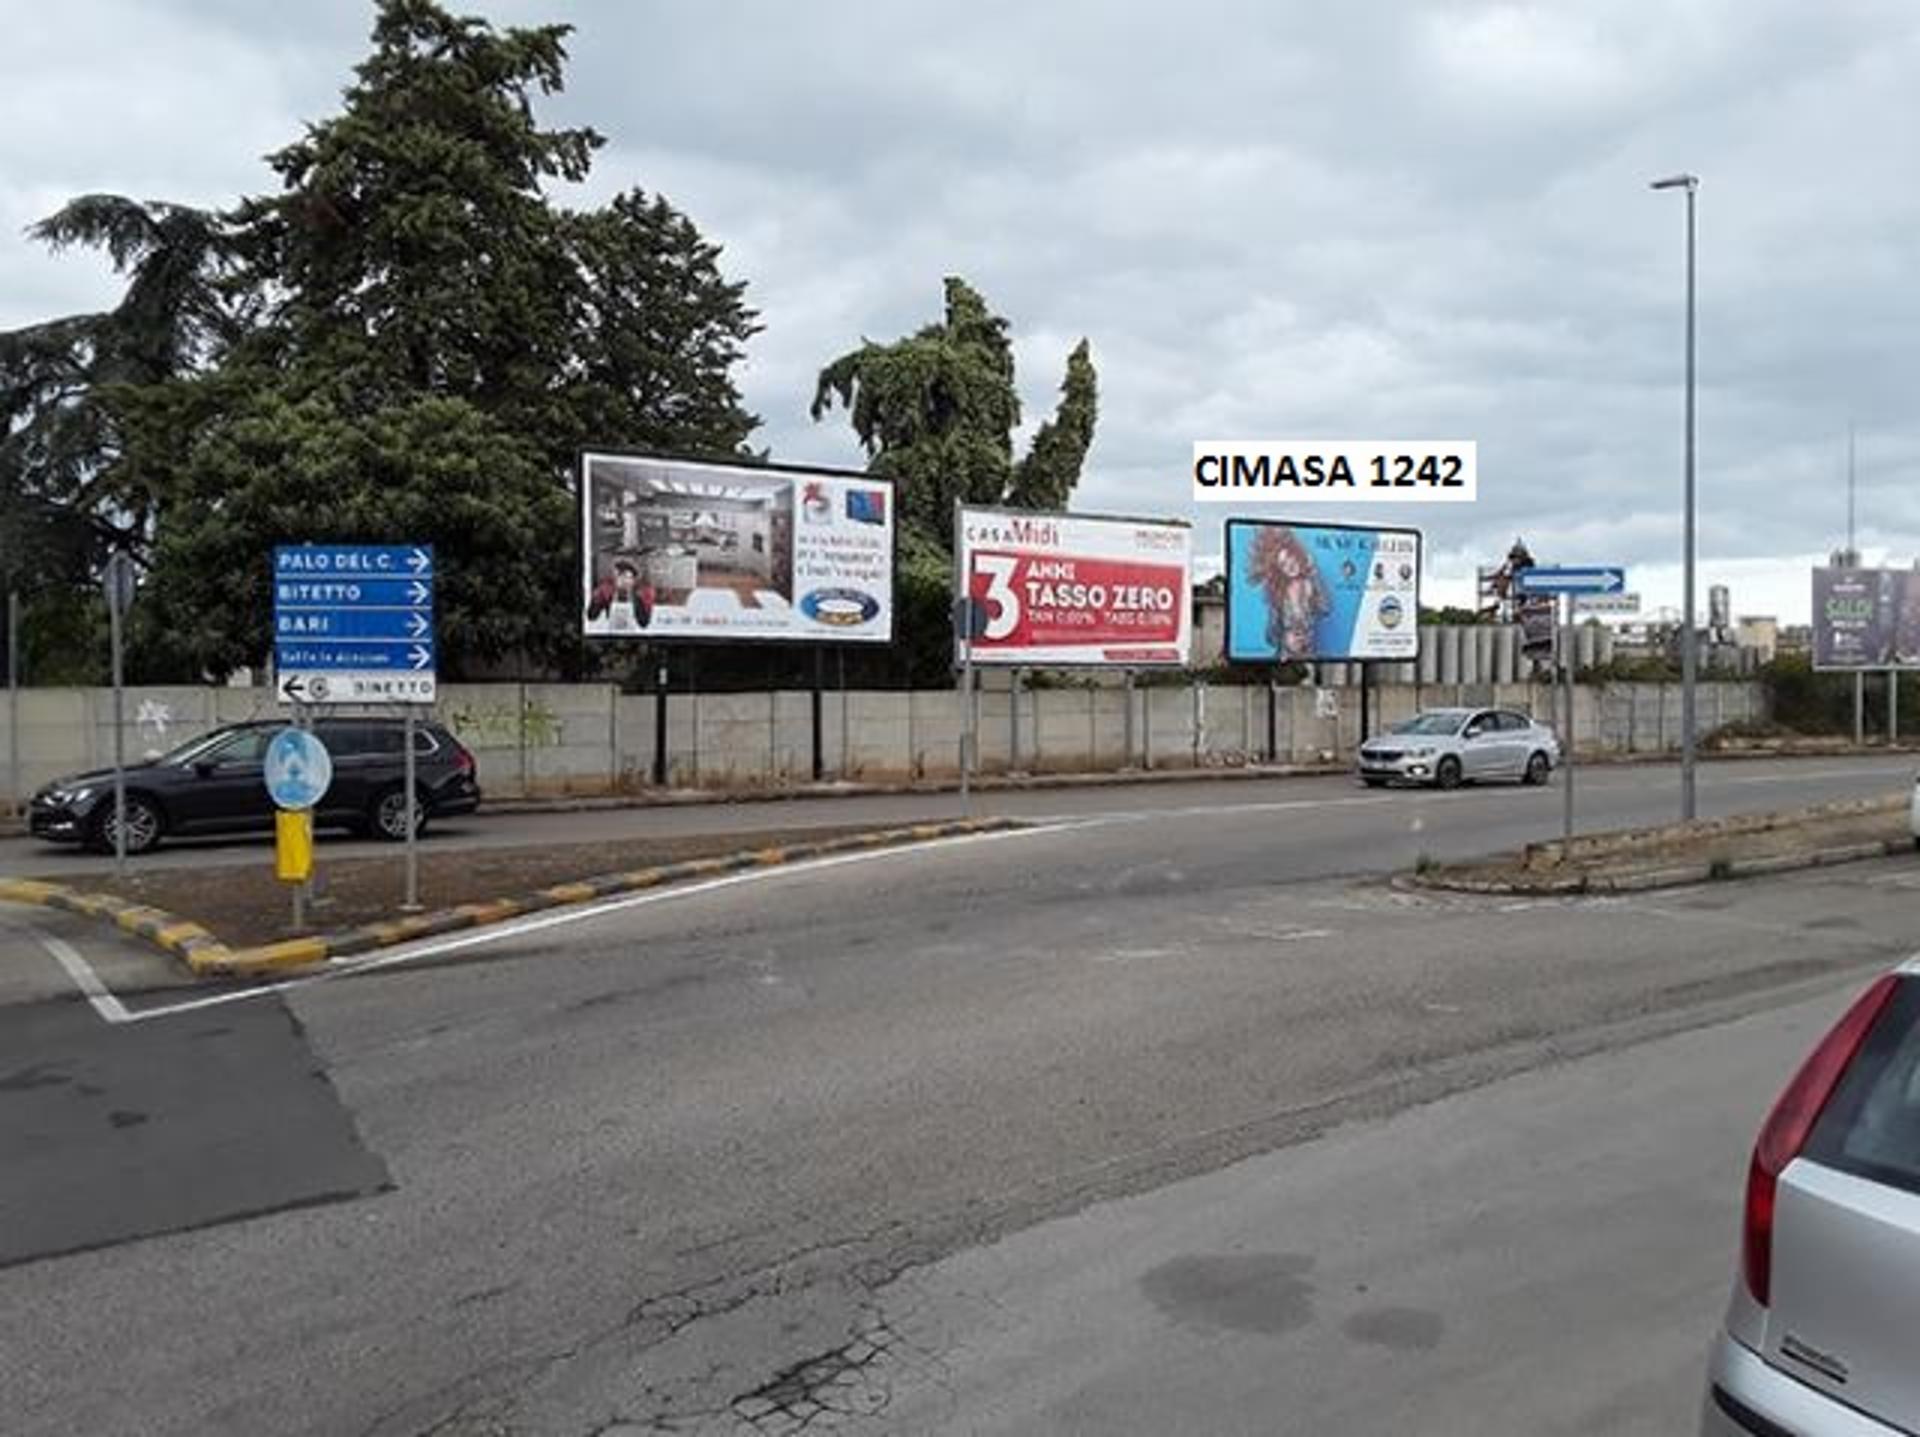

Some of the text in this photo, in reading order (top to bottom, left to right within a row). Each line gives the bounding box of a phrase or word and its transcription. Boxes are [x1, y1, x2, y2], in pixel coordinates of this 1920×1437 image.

[279, 553, 329, 571] PALO
[335, 553, 372, 569] DEL
[1026, 561, 1075, 580] ANNI
[278, 584, 362, 601] BITETTO
[974, 555, 1020, 640] 3
[1026, 583, 1174, 610] TASSO ZERO
[278, 616, 328, 632] BARI
